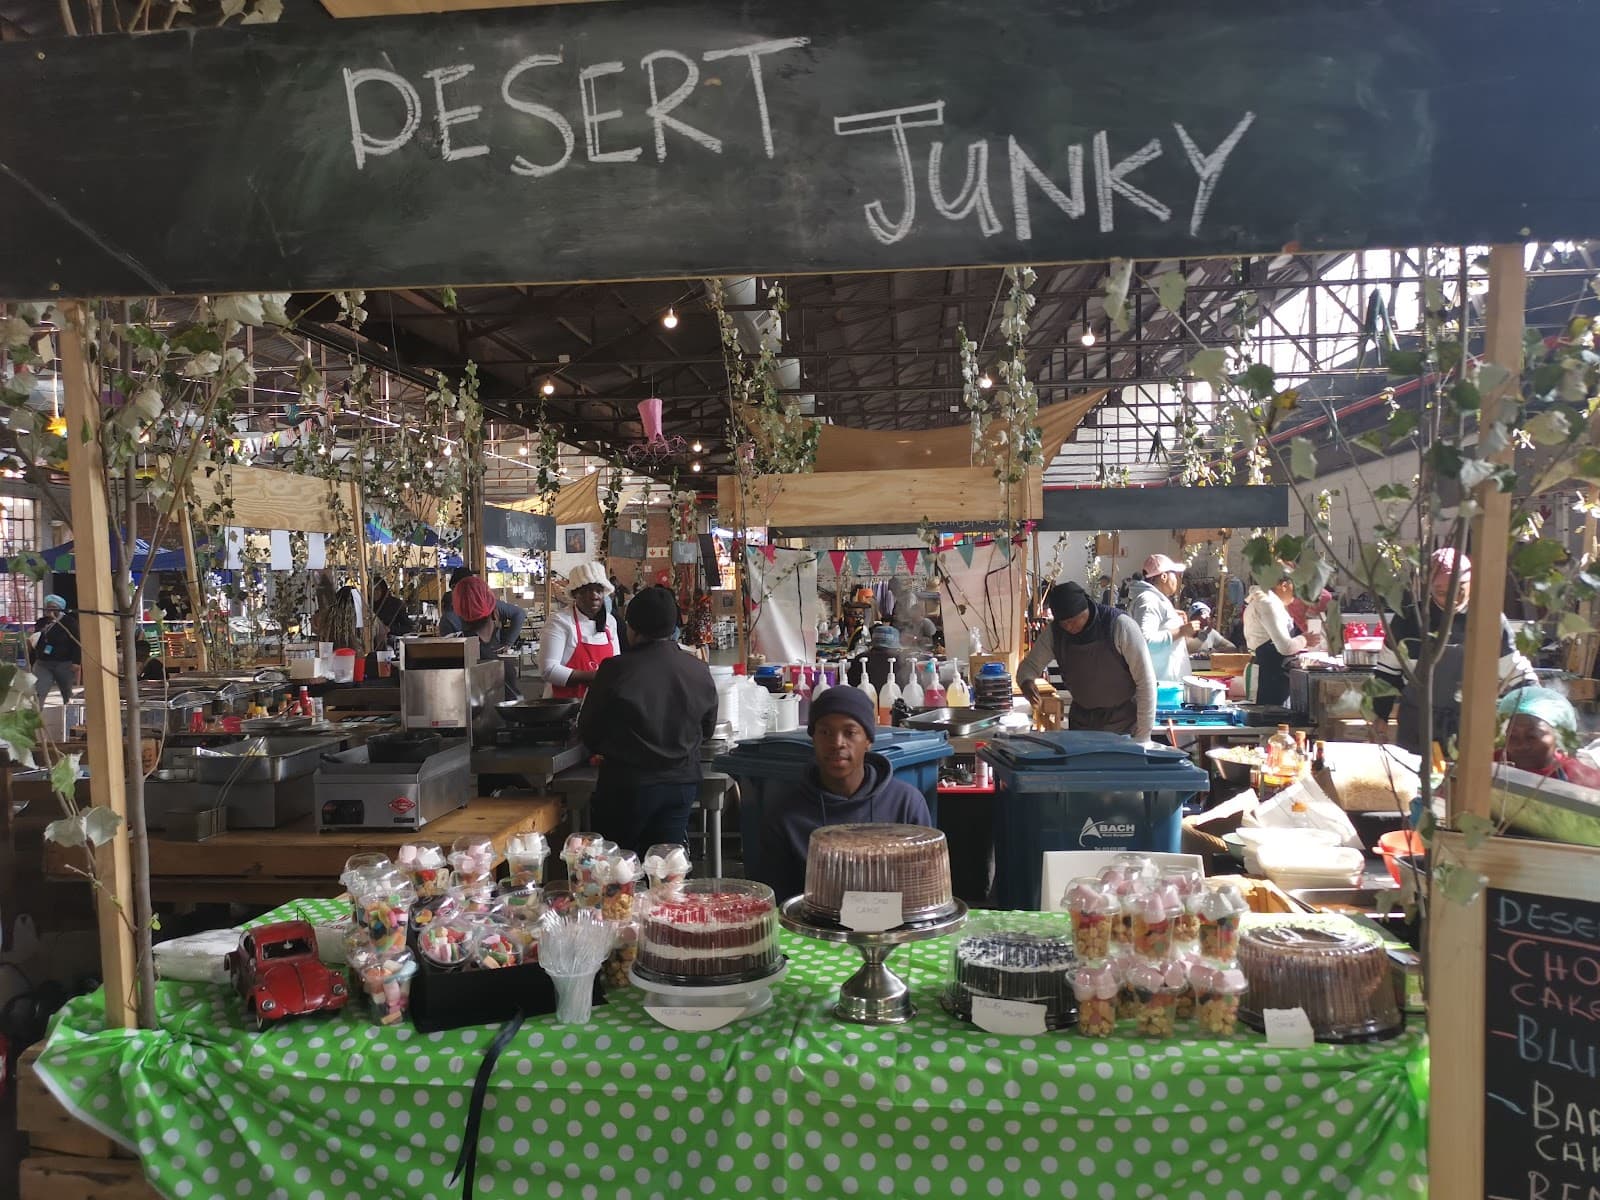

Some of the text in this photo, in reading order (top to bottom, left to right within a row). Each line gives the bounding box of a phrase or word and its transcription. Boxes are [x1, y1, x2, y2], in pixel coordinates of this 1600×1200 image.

[343, 37, 1256, 245] DESERT JUNKY
[1497, 895, 1600, 938] DESE
[1518, 1013, 1596, 1078] BLU
